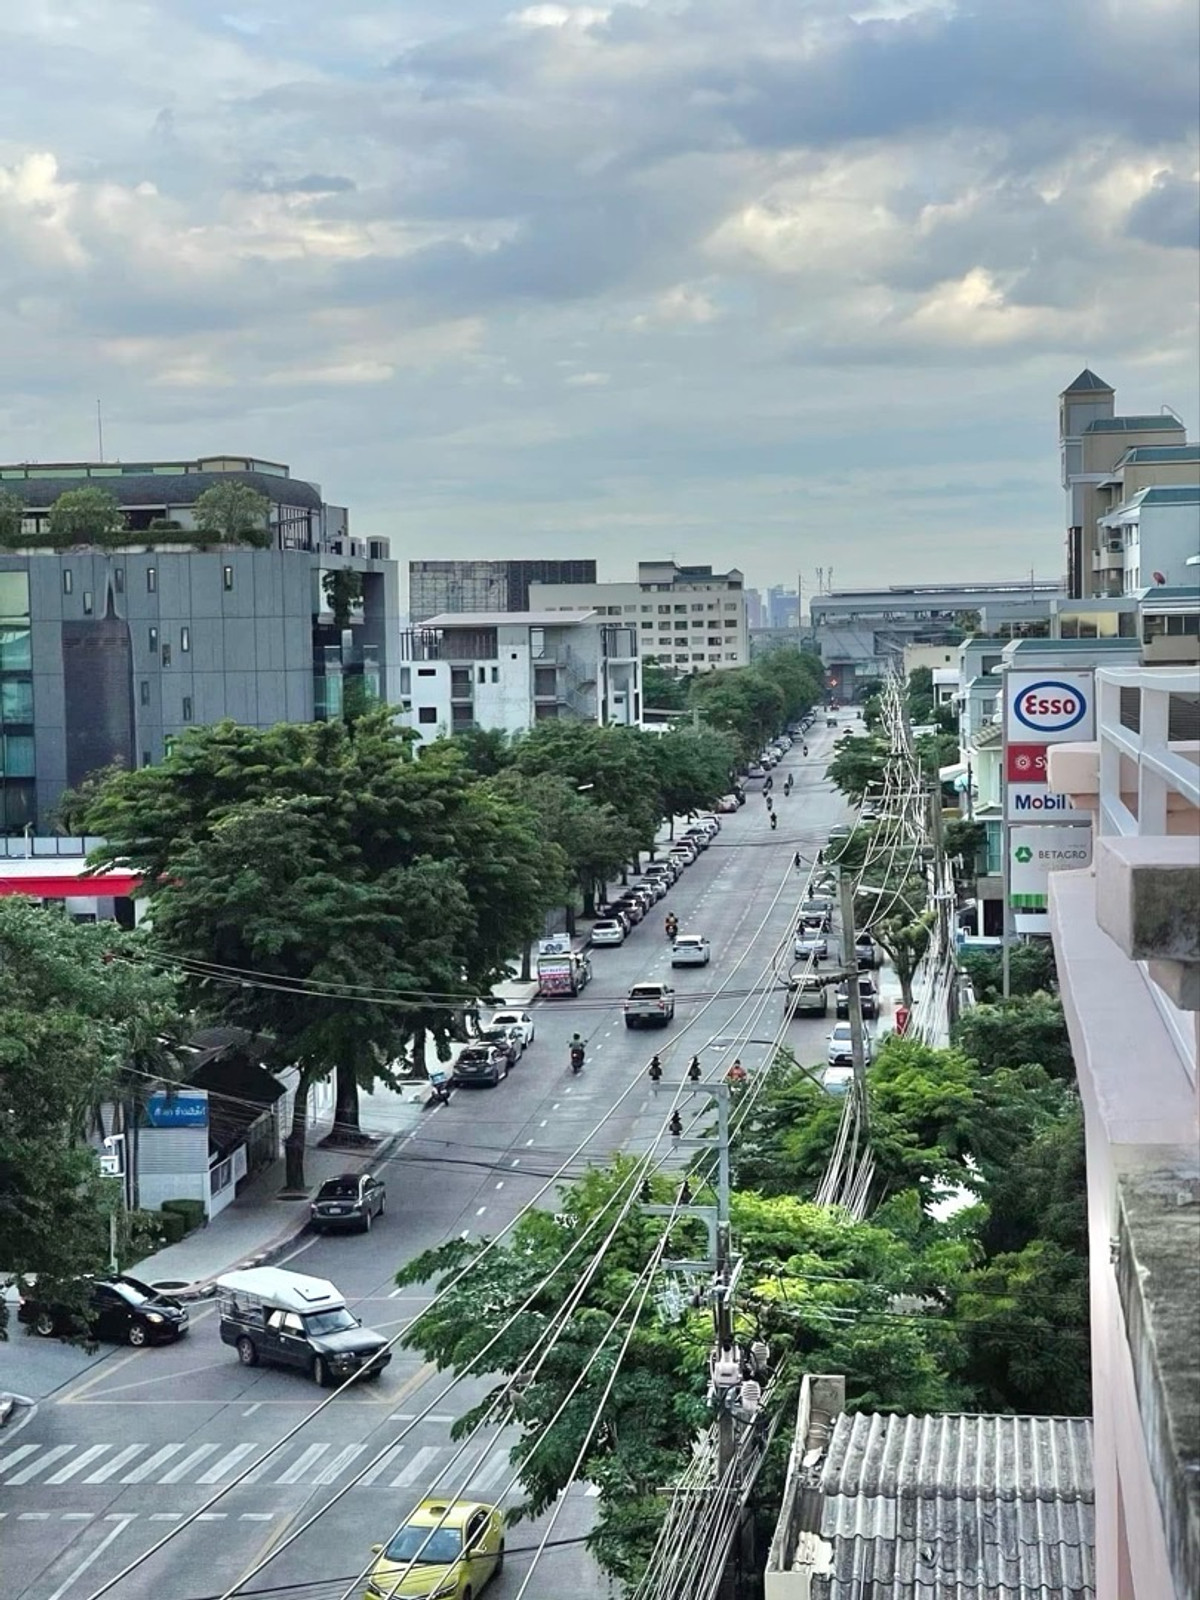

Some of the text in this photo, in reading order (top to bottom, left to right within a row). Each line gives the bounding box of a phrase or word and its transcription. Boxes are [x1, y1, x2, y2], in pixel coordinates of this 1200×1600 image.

[1025, 695, 1076, 715] Esso
[1015, 795, 1065, 810] Mobil
[1038, 850, 1087, 860] BETAGRO
